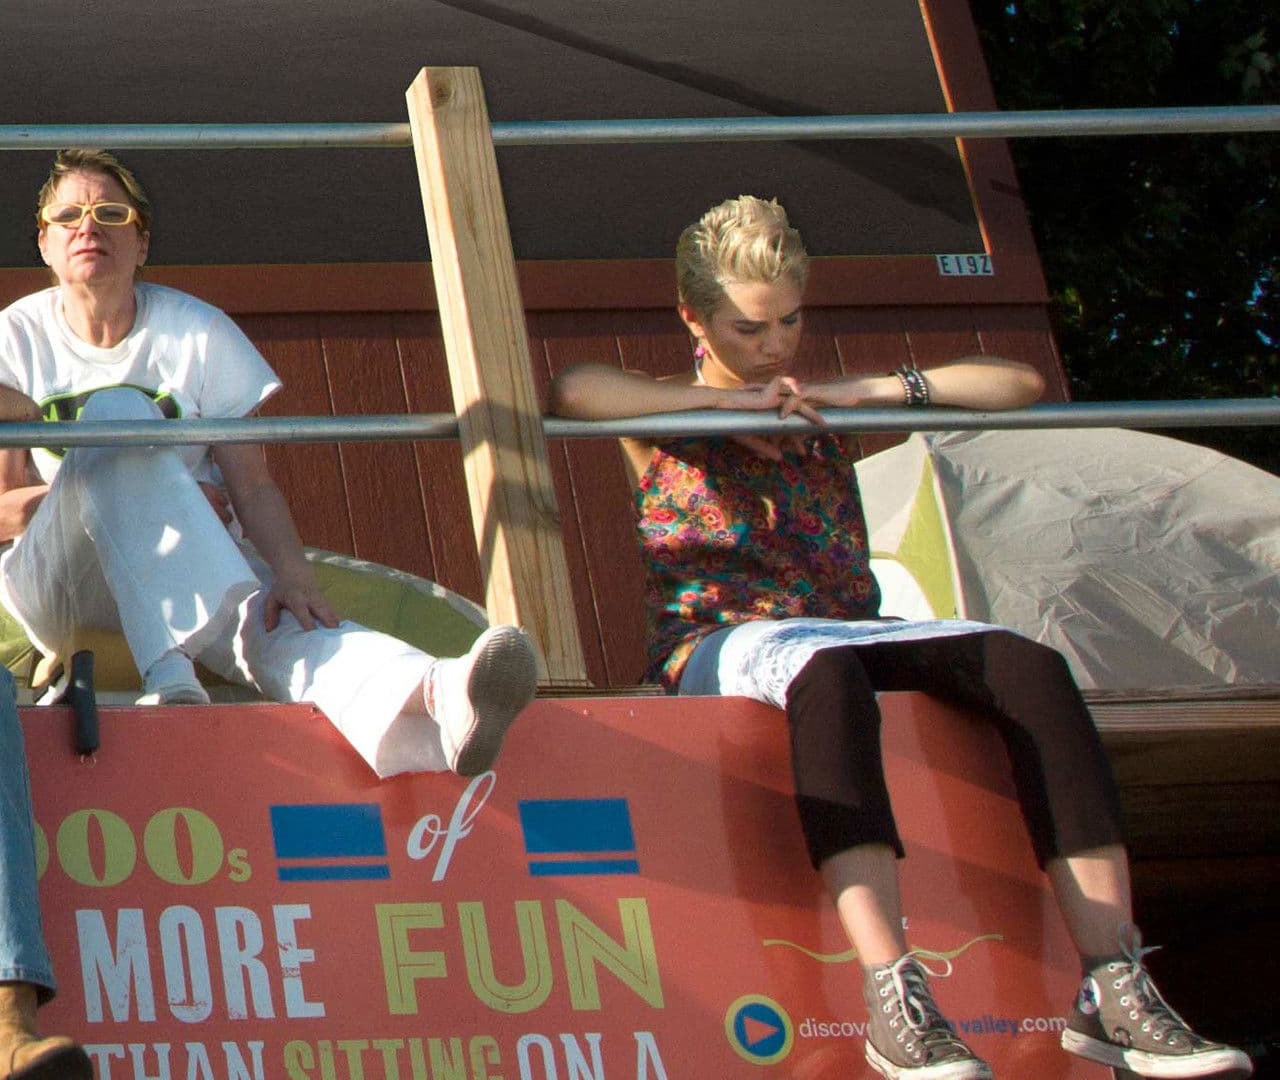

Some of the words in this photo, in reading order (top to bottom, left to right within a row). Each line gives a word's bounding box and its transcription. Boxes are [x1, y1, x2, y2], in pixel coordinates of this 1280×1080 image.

[406, 770, 497, 882] of
[75, 904, 326, 1024] MORE
[374, 897, 665, 1015] FUN
